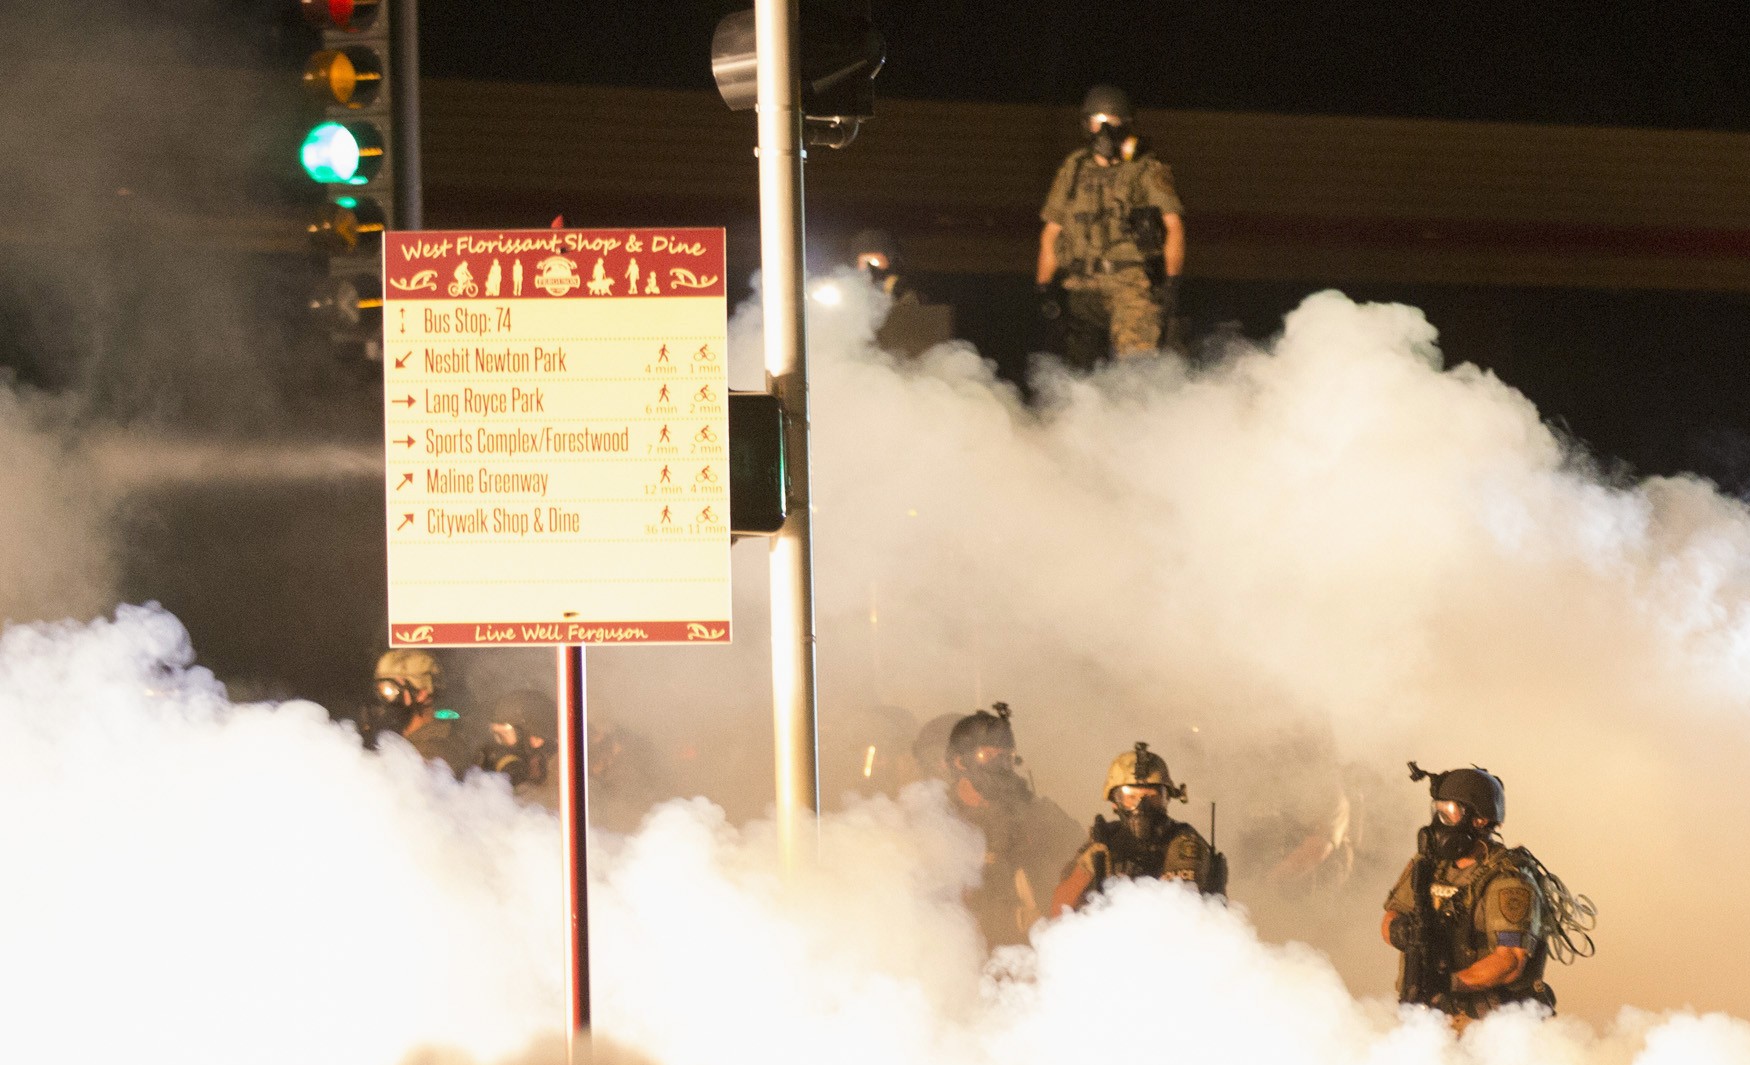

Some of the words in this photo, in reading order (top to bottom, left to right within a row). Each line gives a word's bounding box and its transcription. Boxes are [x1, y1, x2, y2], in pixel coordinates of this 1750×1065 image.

[402, 239, 453, 262] West
[456, 236, 563, 257] Florissant
[564, 233, 622, 256] Shop
[626, 235, 643, 252] &
[652, 236, 707, 257] Dine
[424, 308, 451, 334] Bus
[455, 308, 492, 336] Stop:
[496, 307, 512, 333] 74
[425, 347, 472, 374] Nesbit
[476, 347, 529, 374] Newton
[534, 347, 567, 373] Park
[698, 363, 721, 373] min
[655, 364, 677, 374] min
[426, 388, 460, 417] Lang
[464, 388, 507, 416] Royce
[511, 387, 544, 413] Park
[656, 404, 678, 414] min
[699, 403, 722, 414] min
[426, 428, 473, 457] Sports
[477, 426, 629, 456] Complex/Forestwood
[700, 444, 722, 453] min
[657, 445, 679, 454] min
[426, 468, 474, 494] Maline
[479, 467, 548, 496] Greenway
[701, 484, 723, 494] min
[661, 485, 683, 495] min
[427, 508, 487, 538] Citywalk
[493, 508, 530, 536] Shop
[534, 508, 544, 532] &
[549, 507, 580, 532] Dine
[475, 625, 516, 642] Live
[522, 624, 563, 640] Well
[567, 624, 649, 643] Ferguson
